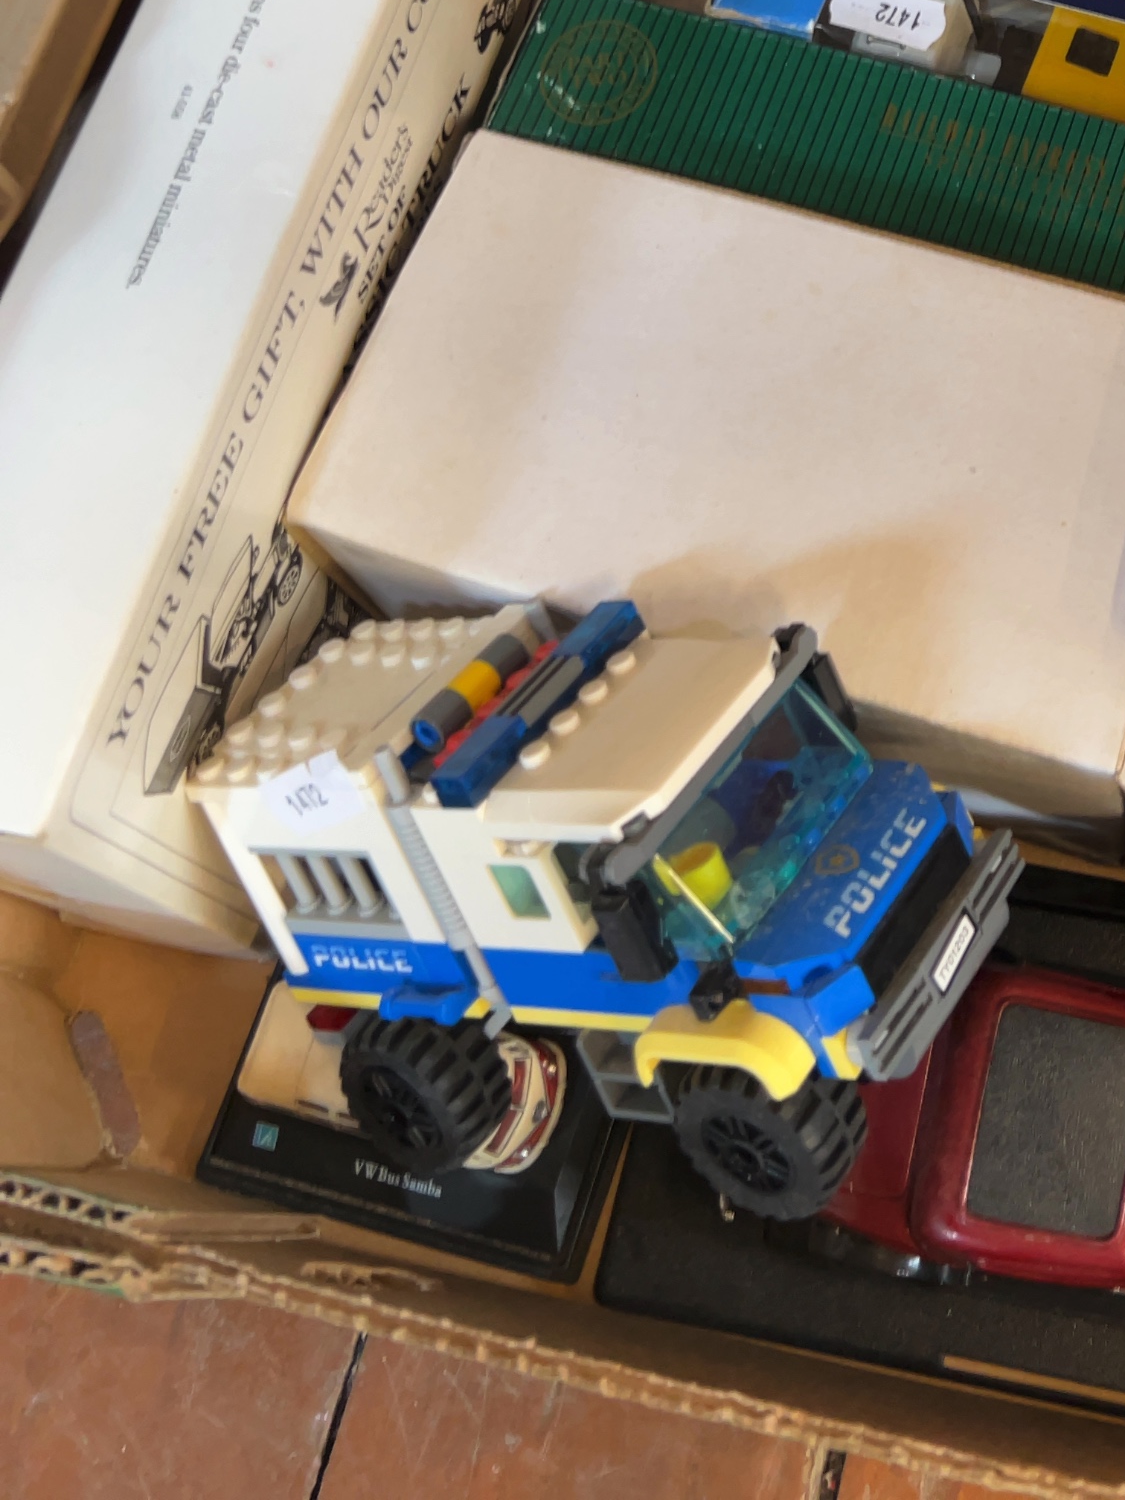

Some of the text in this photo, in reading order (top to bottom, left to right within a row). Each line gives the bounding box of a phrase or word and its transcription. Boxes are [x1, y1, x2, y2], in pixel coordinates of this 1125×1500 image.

[231, 15, 260, 54] four
[874, 1, 922, 31] 1472
[199, 55, 241, 125] die-cast
[173, 128, 207, 182] metal
[353, 121, 409, 253] Reader's
[357, 184, 406, 305] SET OF
[107, 592, 181, 748] YOUR
[177, 431, 245, 587] FREE
[241, 290, 306, 425] GIFT,
[299, 142, 365, 278] WITH
[362, 37, 409, 142] OUR
[284, 782, 330, 816] 1472
[822, 806, 928, 939] POLICE
[311, 943, 413, 974] POLICE
[354, 1157, 442, 1198] VW Bus Samba
